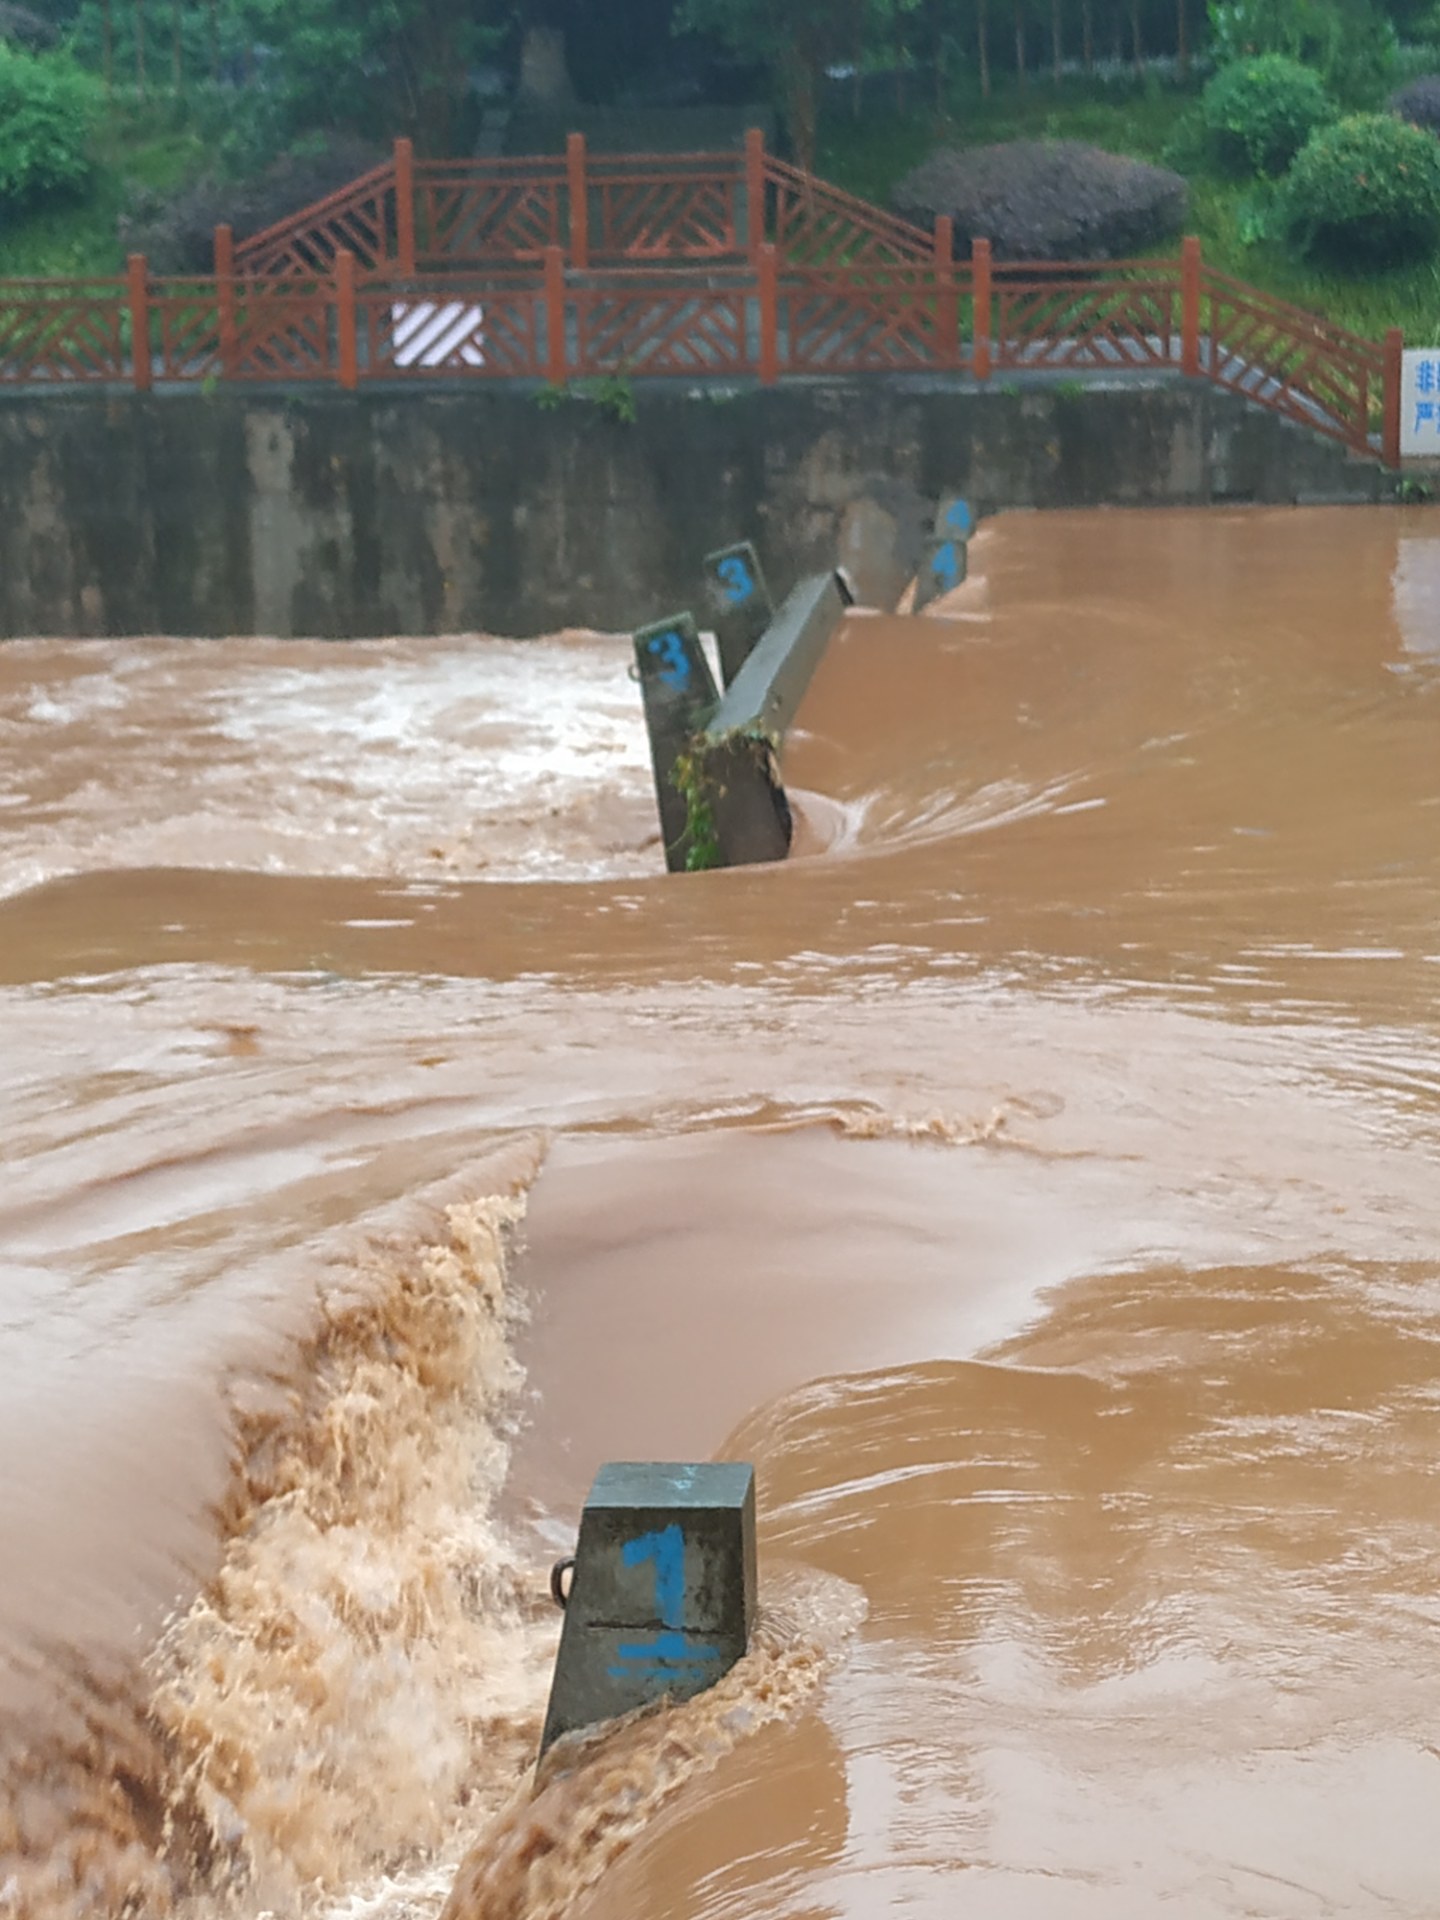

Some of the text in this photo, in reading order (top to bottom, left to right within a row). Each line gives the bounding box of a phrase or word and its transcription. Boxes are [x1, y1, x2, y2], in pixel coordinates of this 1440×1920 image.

[717, 556, 754, 604] 3
[932, 541, 956, 590] 4
[648, 631, 691, 691] 3
[617, 1522, 720, 1660] 1
